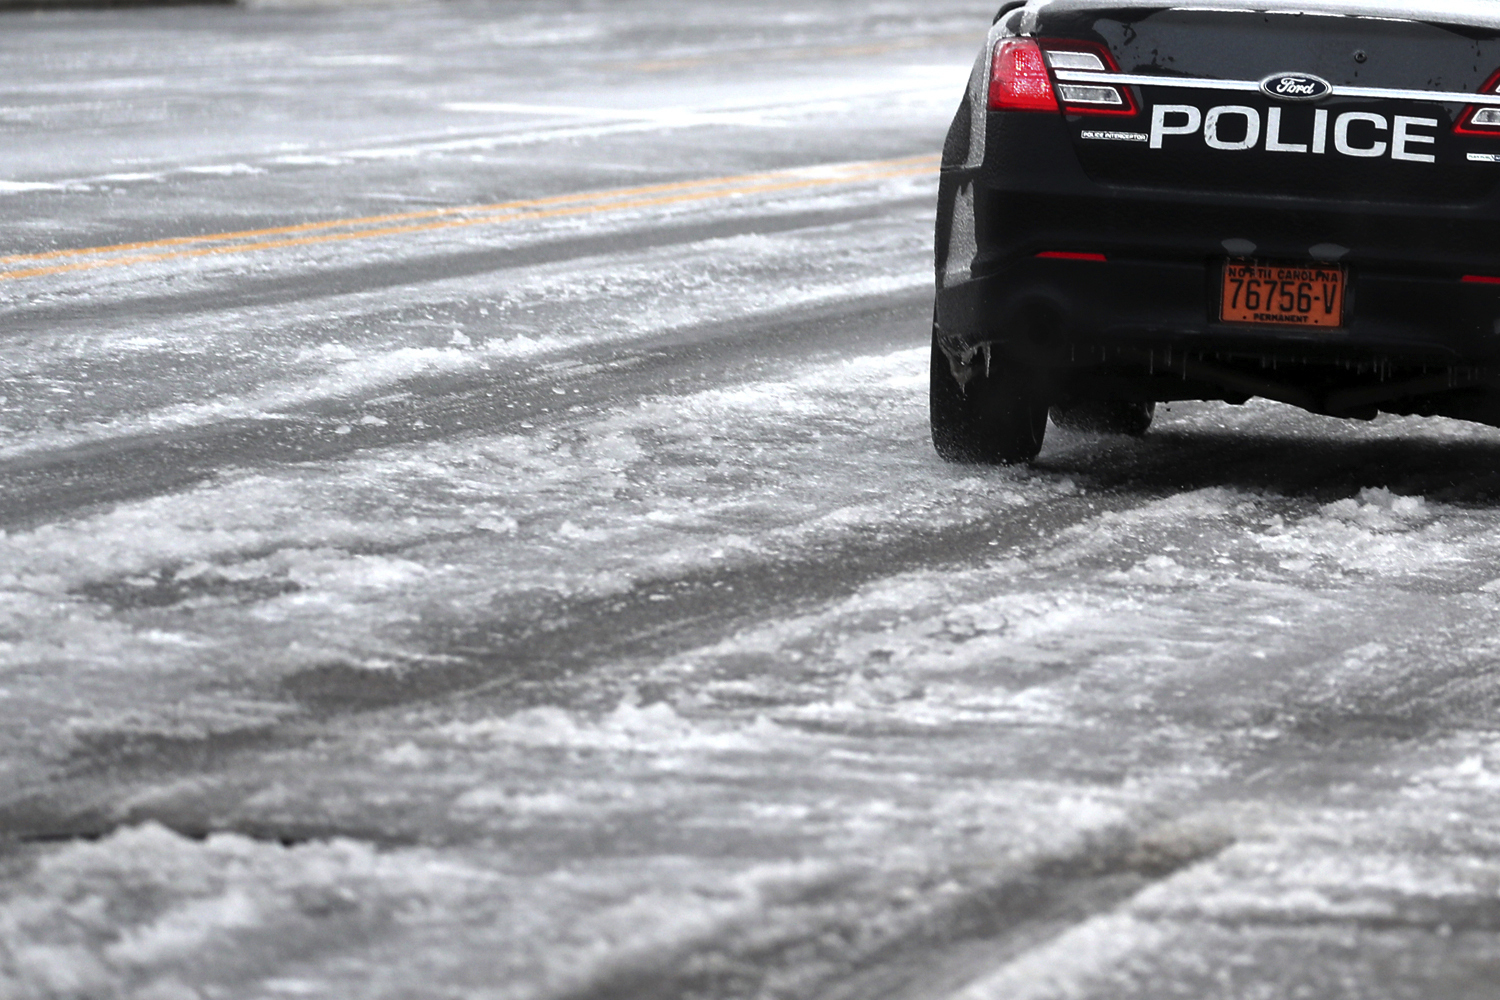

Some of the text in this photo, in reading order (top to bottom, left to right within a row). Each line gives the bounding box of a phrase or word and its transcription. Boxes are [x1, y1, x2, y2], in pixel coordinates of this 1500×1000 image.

[1276, 77, 1315, 94] Ford
[1149, 104, 1438, 163] POLICE
[1228, 267, 1339, 283] NORTH CAROLINA
[1229, 278, 1338, 315] 76756-V
[1253, 313, 1309, 323] PERMANENT
